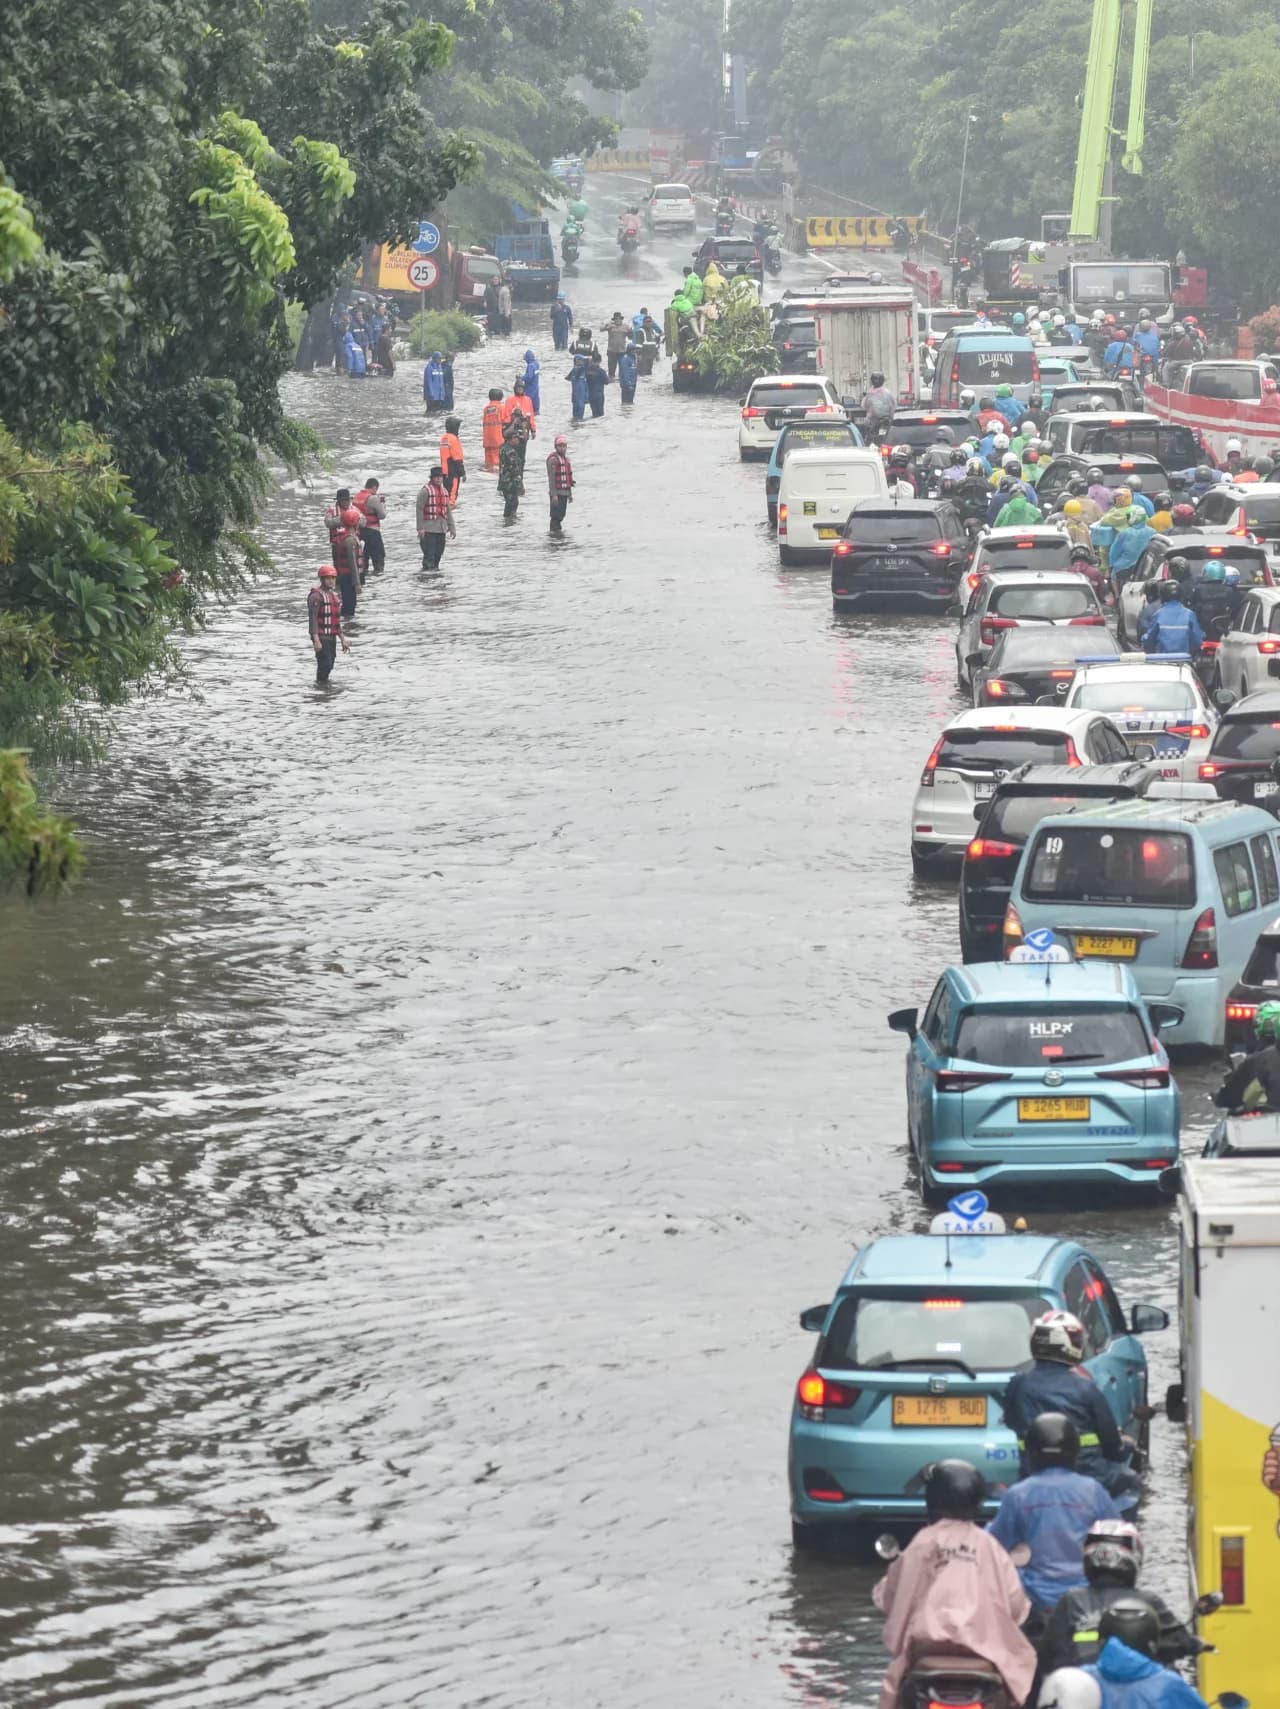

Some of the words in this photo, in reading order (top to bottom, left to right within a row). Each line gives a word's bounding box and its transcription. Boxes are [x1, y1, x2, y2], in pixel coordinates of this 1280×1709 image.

[414, 266, 429, 281] 25
[1046, 837, 1063, 854] 19
[1021, 952, 1060, 961] TAKSI
[1030, 1023, 1061, 1035] HLP
[944, 1222, 993, 1232] TAKSI
[897, 1400, 904, 1414] B
[986, 1450, 1007, 1460] HD
